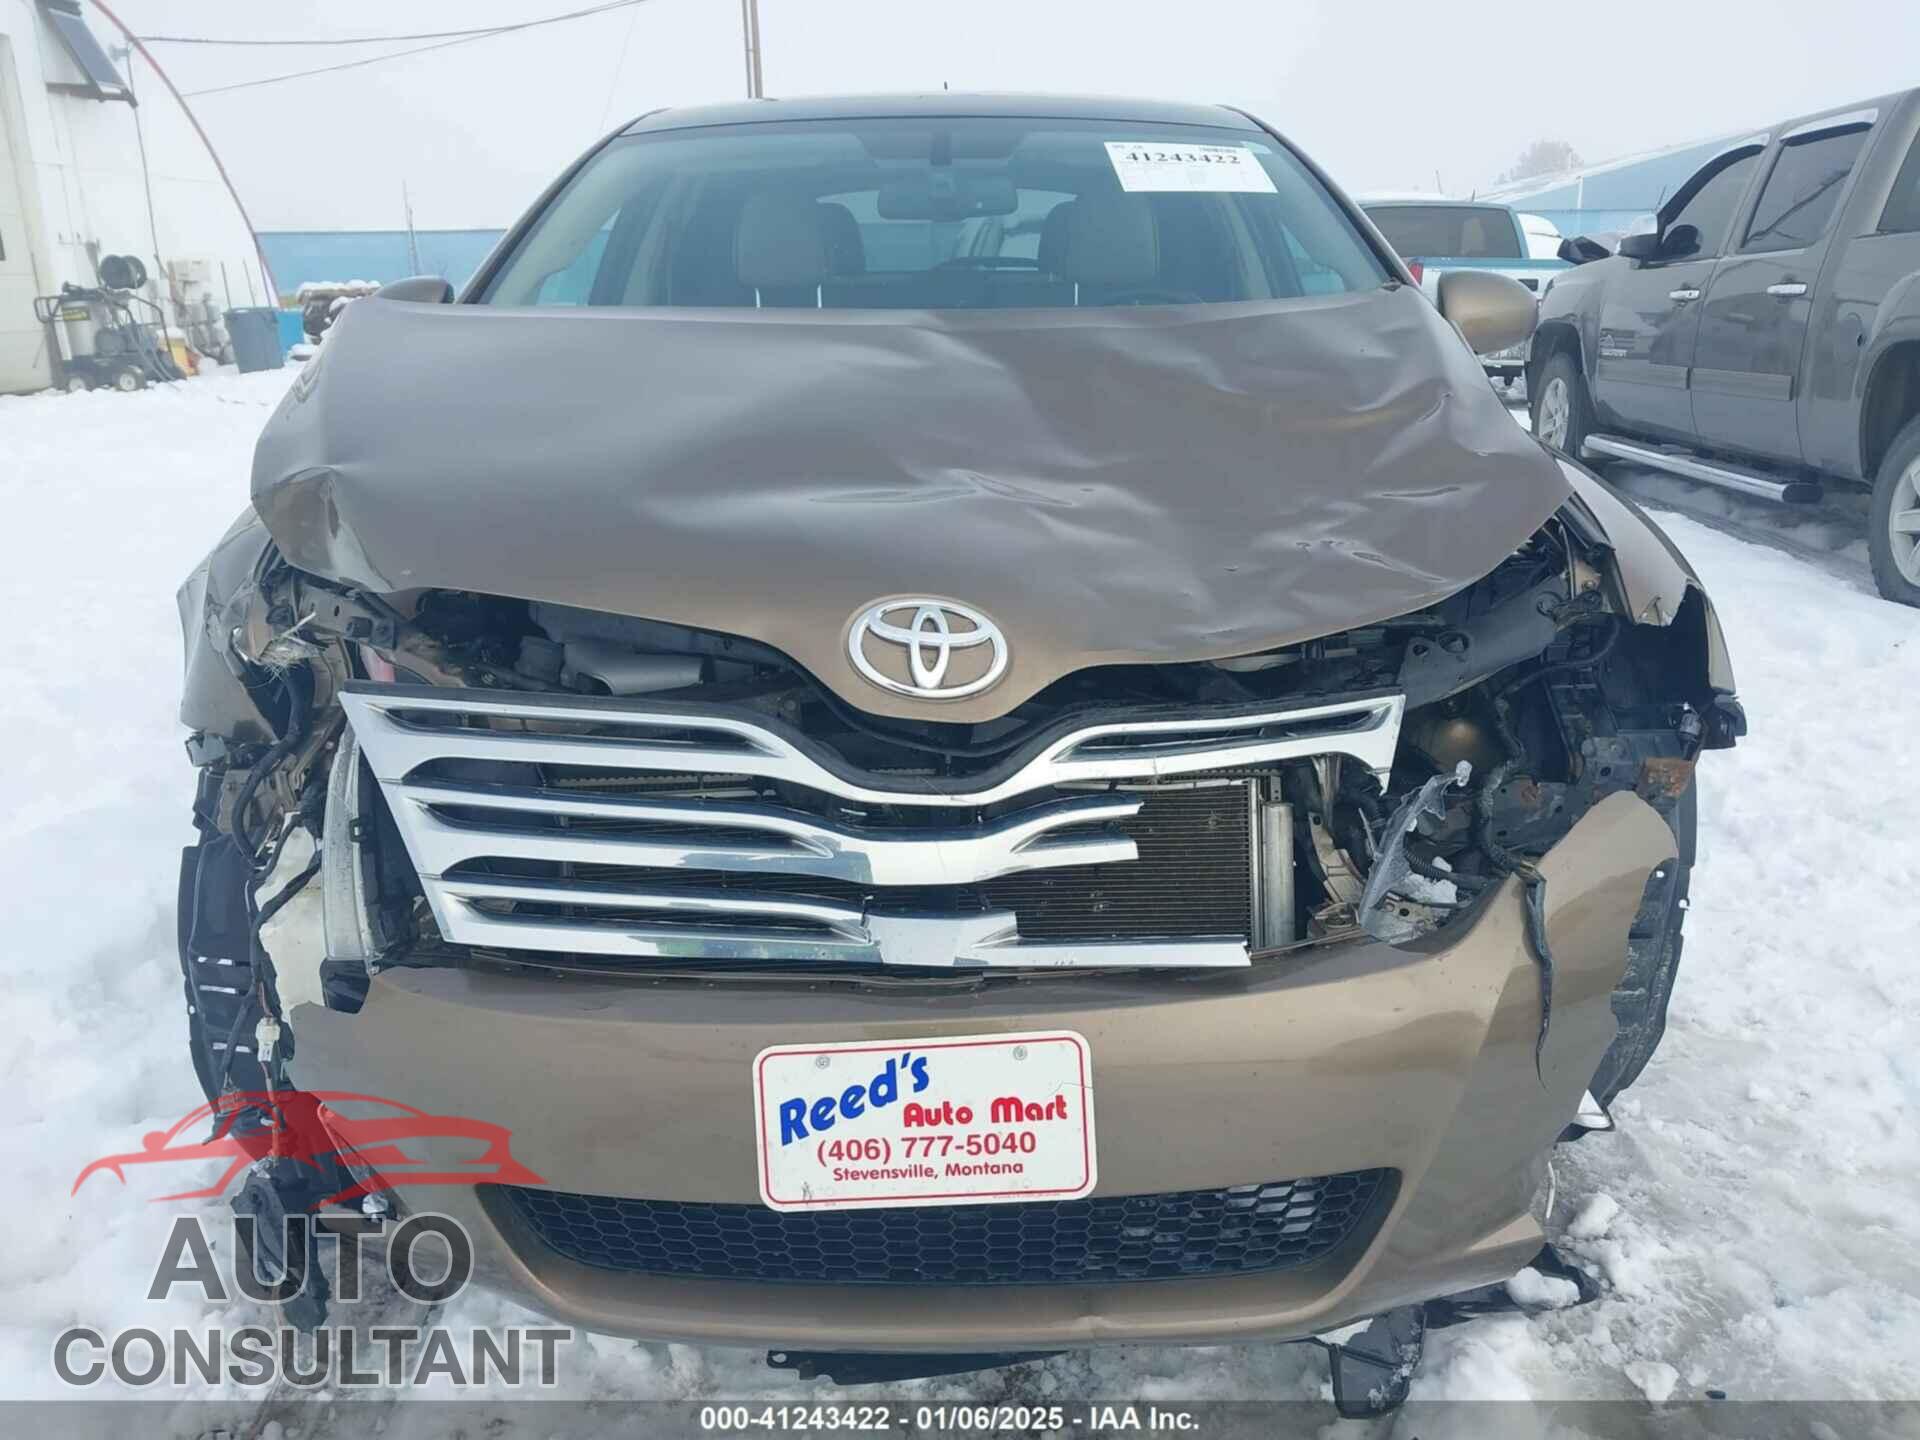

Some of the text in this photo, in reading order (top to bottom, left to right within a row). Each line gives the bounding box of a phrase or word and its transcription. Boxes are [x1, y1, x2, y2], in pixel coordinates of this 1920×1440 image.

[1126, 152, 1241, 164] 41243422
[779, 1052, 930, 1146] Reed's
[903, 1095, 1067, 1128] Auto Mart
[817, 1131, 1037, 1167] (406) 777-5040
[833, 1161, 1023, 1181] Stevensville, Montana
